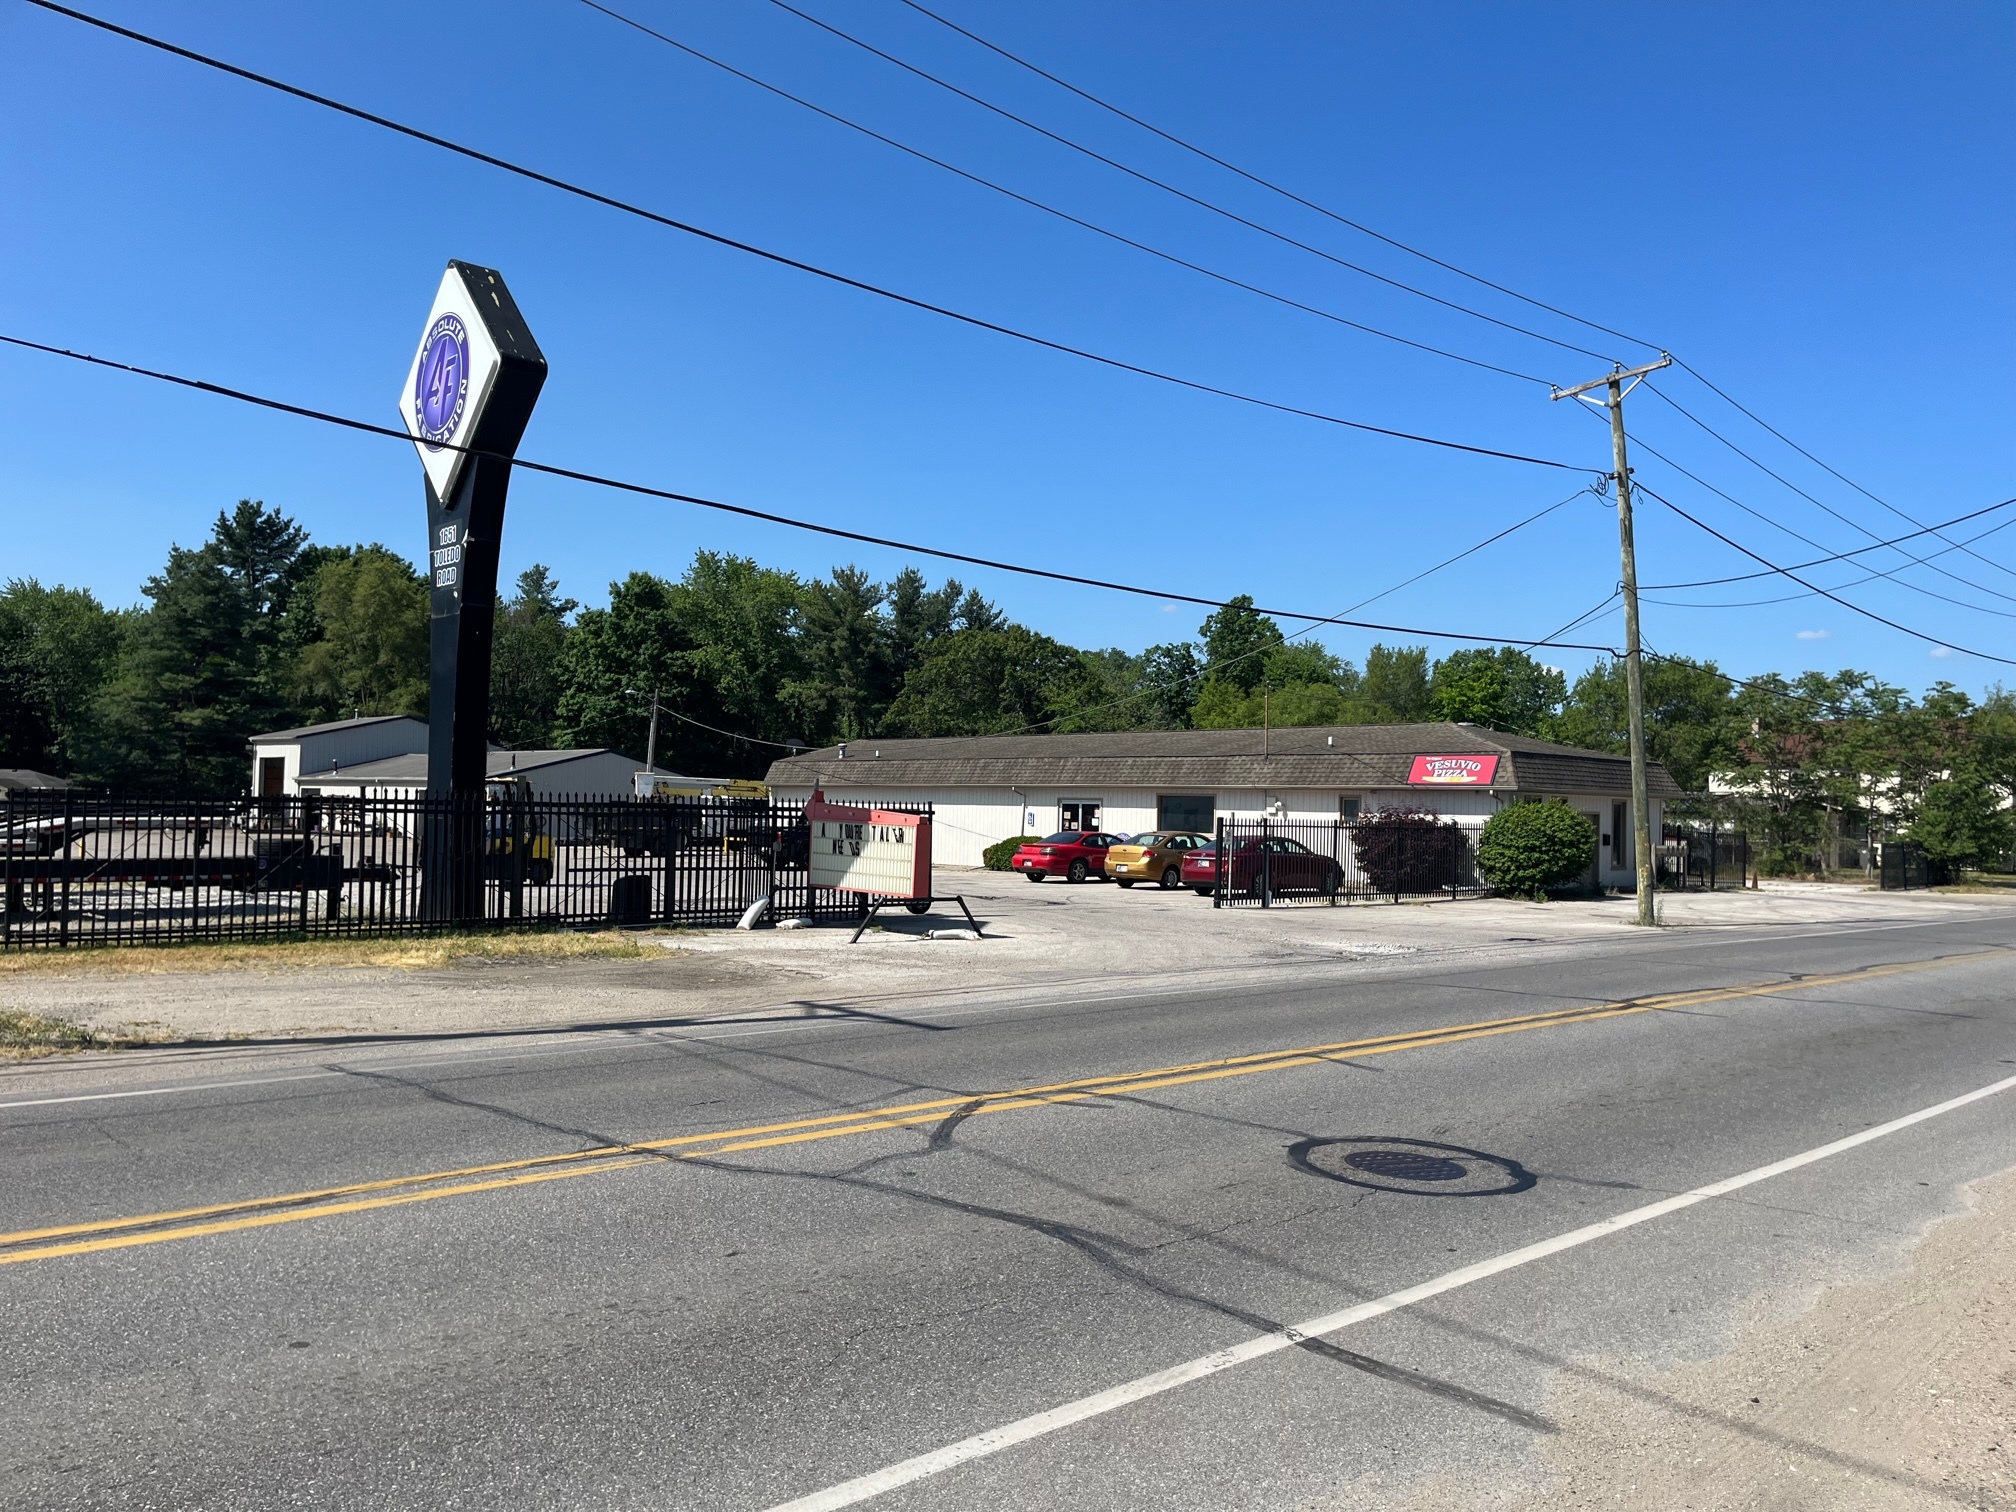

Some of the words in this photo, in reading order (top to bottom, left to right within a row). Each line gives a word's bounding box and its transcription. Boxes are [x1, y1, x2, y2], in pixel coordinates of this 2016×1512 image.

[422, 318, 466, 364] ABSOLUTE
[439, 525, 457, 545] 1651
[434, 544, 461, 567] TOLEDO
[436, 567, 457, 587] ROAD
[1425, 760, 1482, 771] VESUVIO
[1433, 769, 1468, 777] PIZZA
[821, 822, 826, 838] A
